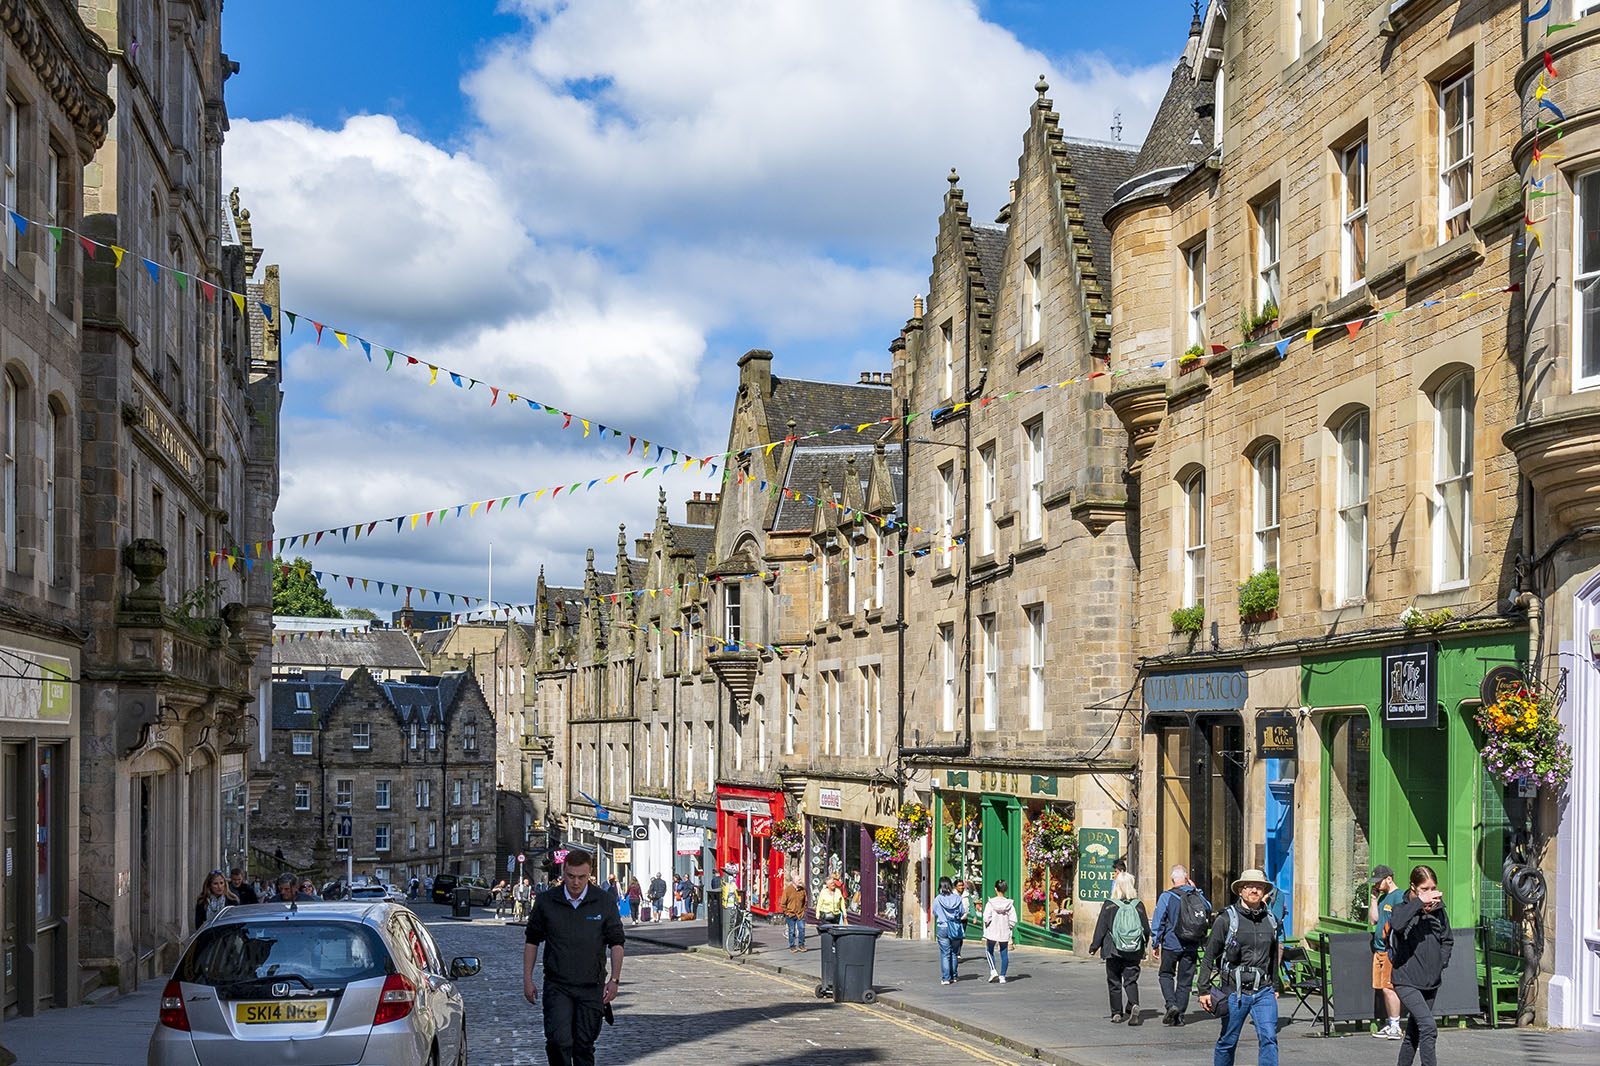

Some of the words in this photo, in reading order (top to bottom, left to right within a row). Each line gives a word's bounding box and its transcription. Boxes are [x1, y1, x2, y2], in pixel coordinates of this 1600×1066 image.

[144, 405, 158, 436] THE
[1403, 661, 1420, 681] The
[1150, 678, 1178, 701] VIVA
[1183, 675, 1242, 700] MEXICO
[1403, 679, 1425, 701] Wall
[1274, 726, 1288, 736] The
[1274, 735, 1294, 745] Wall
[980, 770, 1019, 792] EDEN
[1080, 870, 1116, 880] HOME
[1092, 881, 1100, 889] &
[1080, 889, 1109, 898] GIFT
[247, 1006, 281, 1020] SK14
[287, 1004, 317, 1019] NKG
